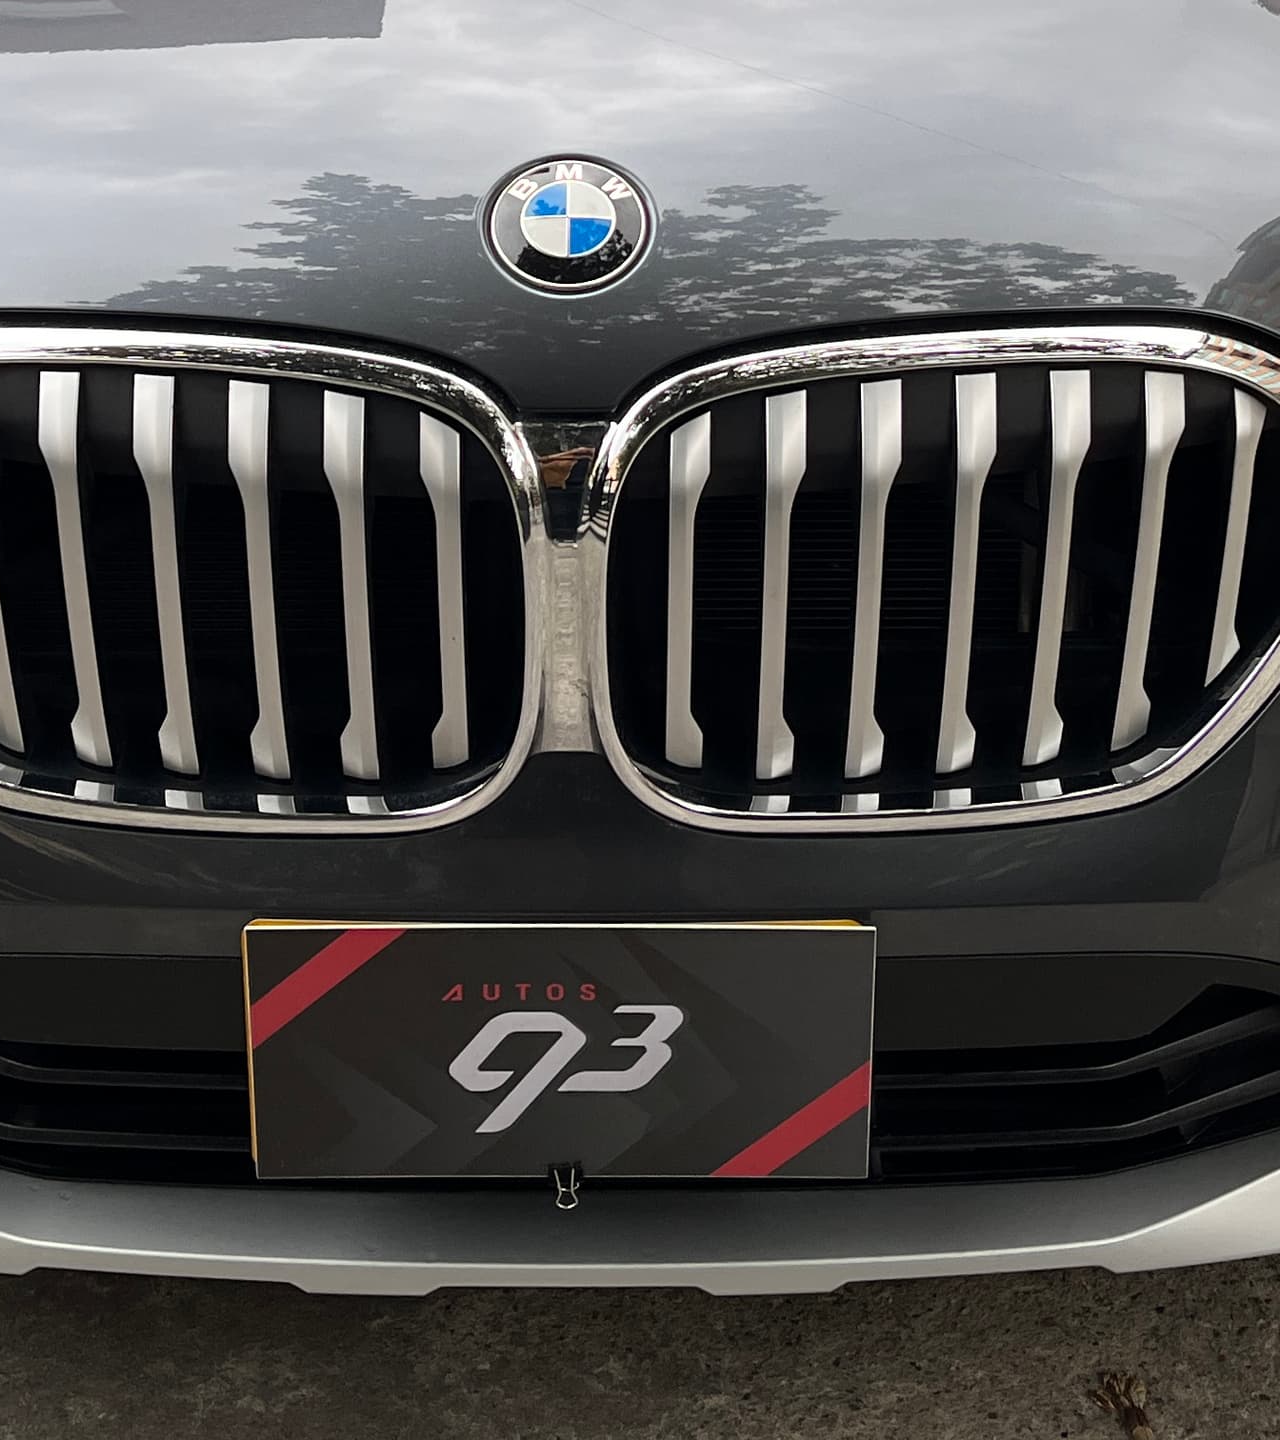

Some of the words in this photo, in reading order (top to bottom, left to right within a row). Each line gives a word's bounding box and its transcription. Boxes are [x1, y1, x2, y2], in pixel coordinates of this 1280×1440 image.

[507, 163, 632, 201] BMW
[441, 983, 597, 1002] AUTOS
[448, 1004, 685, 1133] 93
